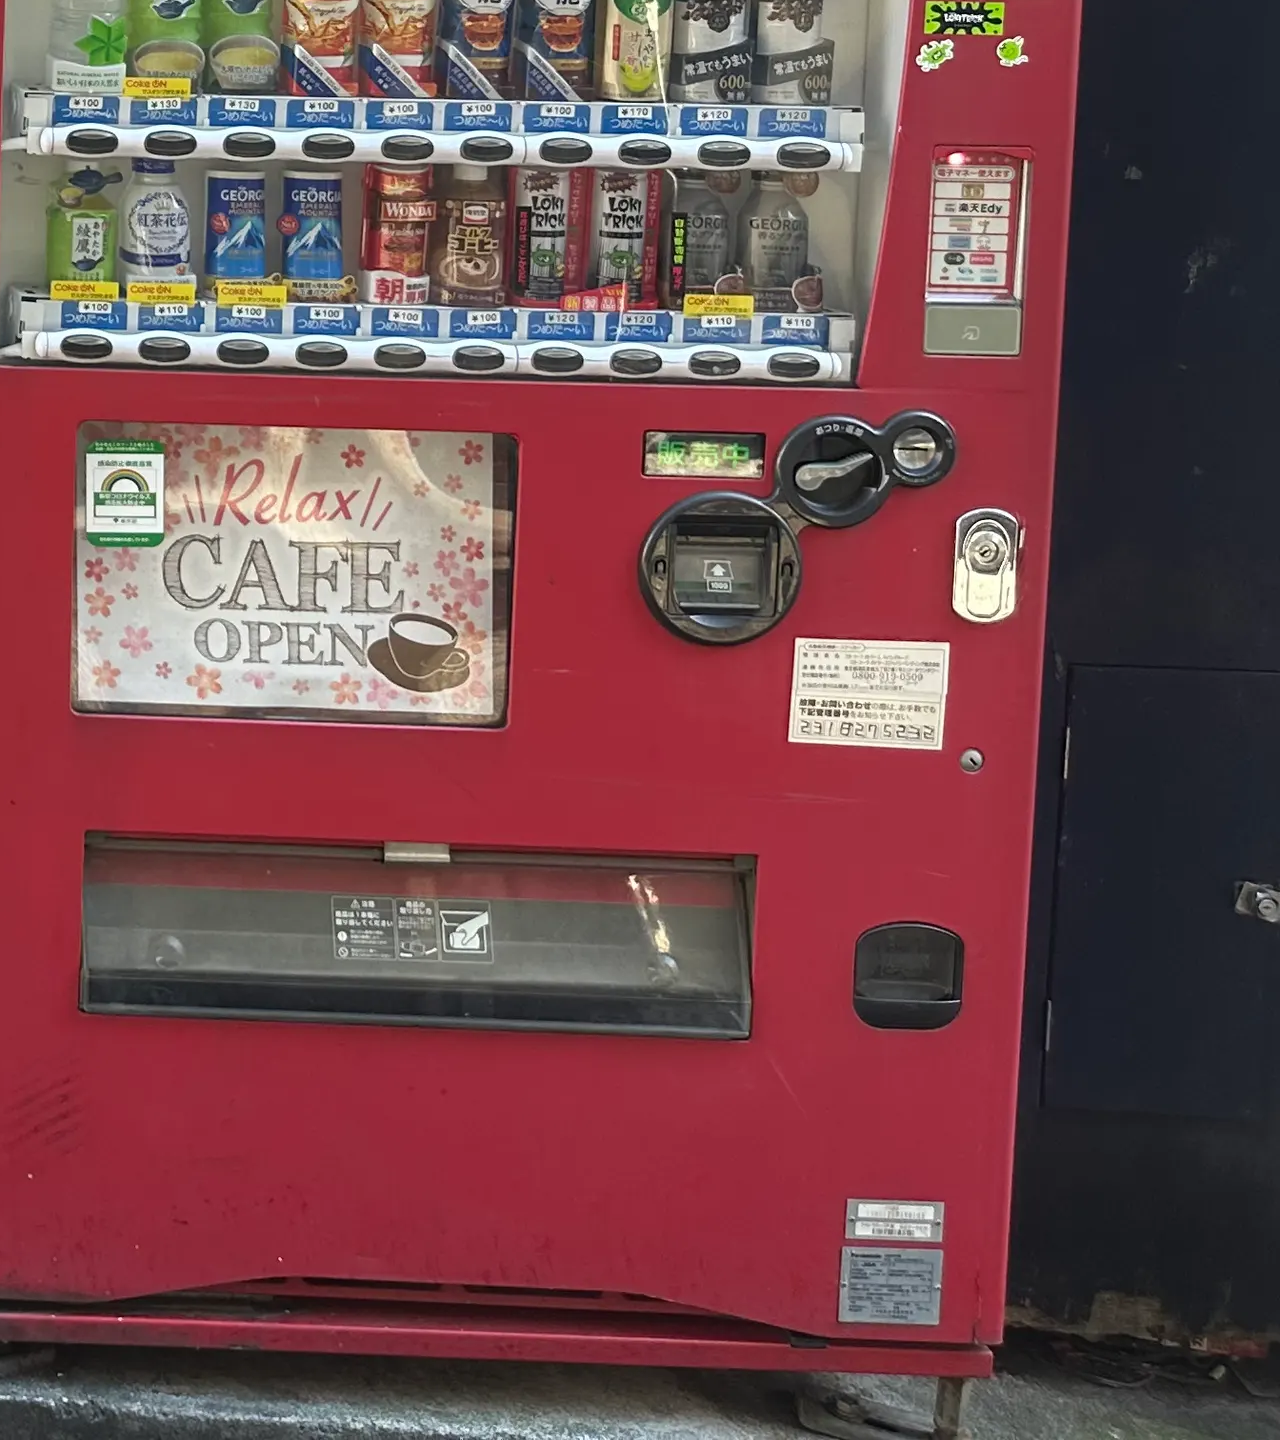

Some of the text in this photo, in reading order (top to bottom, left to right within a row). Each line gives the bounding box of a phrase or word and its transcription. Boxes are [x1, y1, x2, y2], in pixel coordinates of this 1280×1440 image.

[685, 53, 753, 76] 常温でもうまい
[773, 53, 832, 76] 常温でもうまい
[73, 98, 99, 107] ¥100
[151, 100, 178, 109] ¥130
[229, 100, 256, 109] ¥130
[309, 101, 335, 110] ¥100
[701, 110, 728, 119] ¥120
[780, 111, 807, 120] ¥120
[385, 201, 433, 217] WONDA
[531, 196, 564, 211] LOKI
[608, 197, 642, 211] LOKI
[958, 203, 1003, 214] 楽天Edy
[137, 213, 188, 227] 紅茶花伝
[602, 212, 644, 229] TRICK
[456, 226, 492, 238] ミルク
[447, 234, 499, 254] コーヒー
[130, 285, 154, 294] Coke
[374, 277, 404, 304] 朝
[83, 303, 108, 312] ¥100
[158, 305, 184, 314] ¥110
[472, 313, 497, 322] ¥100
[548, 314, 575, 323] ¥120
[626, 315, 653, 324] ¥120
[706, 316, 732, 325] ¥110
[786, 318, 812, 327] ¥110
[656, 440, 751, 468] 販売中
[213, 453, 361, 526] Relax
[162, 533, 405, 614] CAFE
[194, 617, 375, 668] OPEN
